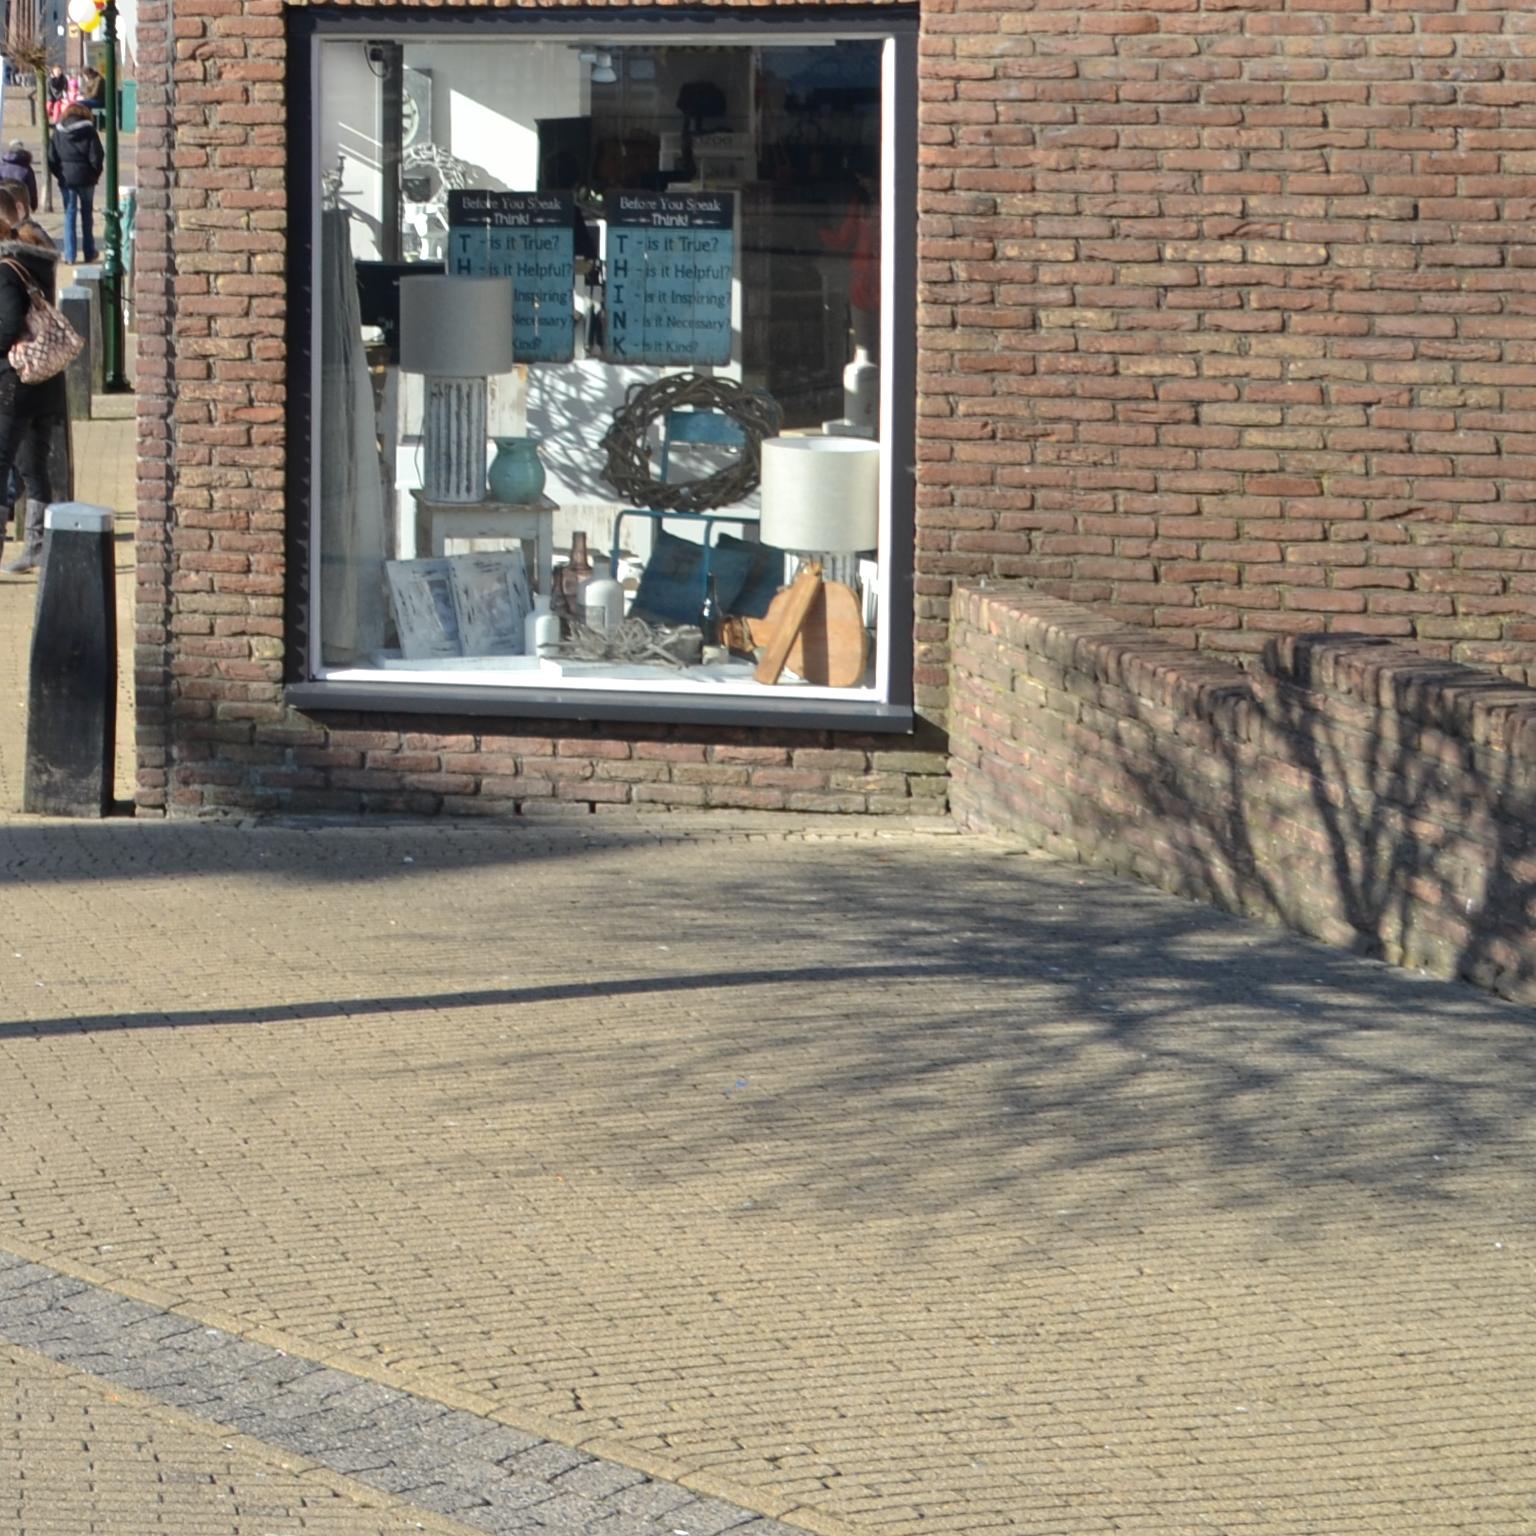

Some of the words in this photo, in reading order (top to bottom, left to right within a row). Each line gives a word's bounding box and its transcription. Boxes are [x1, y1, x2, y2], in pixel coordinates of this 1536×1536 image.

[462, 196, 498, 210] Before
[502, 196, 525, 210] You
[528, 196, 562, 212] Speak
[620, 196, 656, 210] Before
[660, 196, 683, 210] You
[686, 197, 722, 213] Speak
[459, 234, 471, 253] T
[490, 236, 501, 250] is
[506, 236, 516, 250] it
[522, 235, 560, 251] True?
[616, 235, 628, 254] T
[647, 237, 659, 251] is
[664, 237, 674, 251] it
[678, 236, 719, 253] True?
[457, 258, 471, 275] H
[489, 263, 501, 276] is
[504, 263, 513, 276] it
[516, 262, 572, 279] Helpful?
[614, 259, 628, 278] H
[646, 264, 657, 277] is
[661, 264, 670, 277] it
[674, 263, 731, 282] Helpful?
[613, 285, 624, 304] I
[644, 290, 654, 303] is
[658, 290, 667, 303] it
[613, 312, 627, 330] N
[643, 316, 652, 327] is
[655, 316, 663, 327] it
[613, 337, 626, 355] K
[654, 341, 662, 353] it
